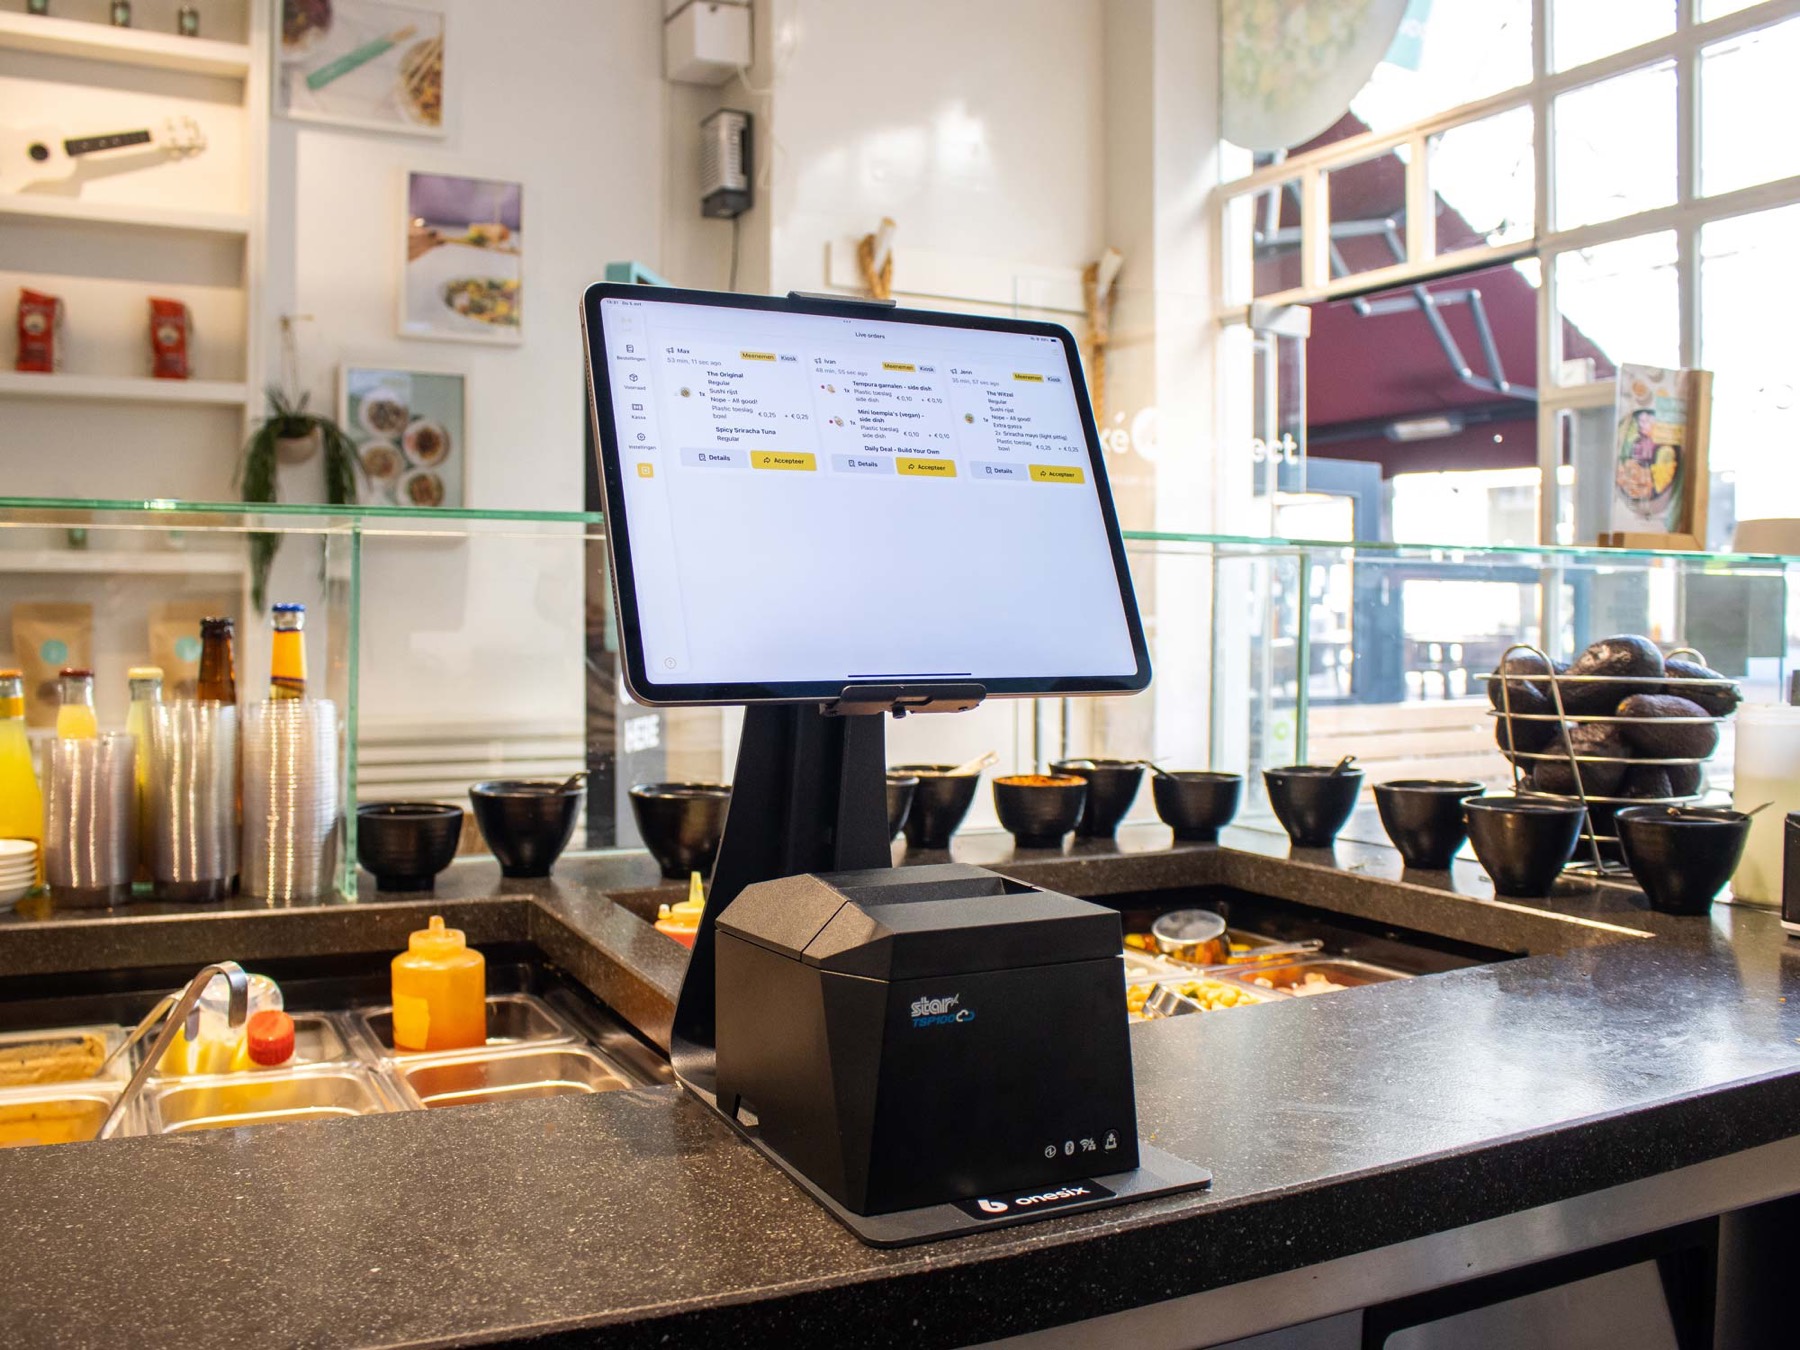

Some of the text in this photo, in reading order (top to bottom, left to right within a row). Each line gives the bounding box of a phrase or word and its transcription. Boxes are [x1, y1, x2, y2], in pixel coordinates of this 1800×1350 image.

[720, 371, 744, 379] Original
[774, 457, 804, 465] Accepteer
[911, 996, 956, 1017] star
[1015, 1186, 1091, 1206] onesix
